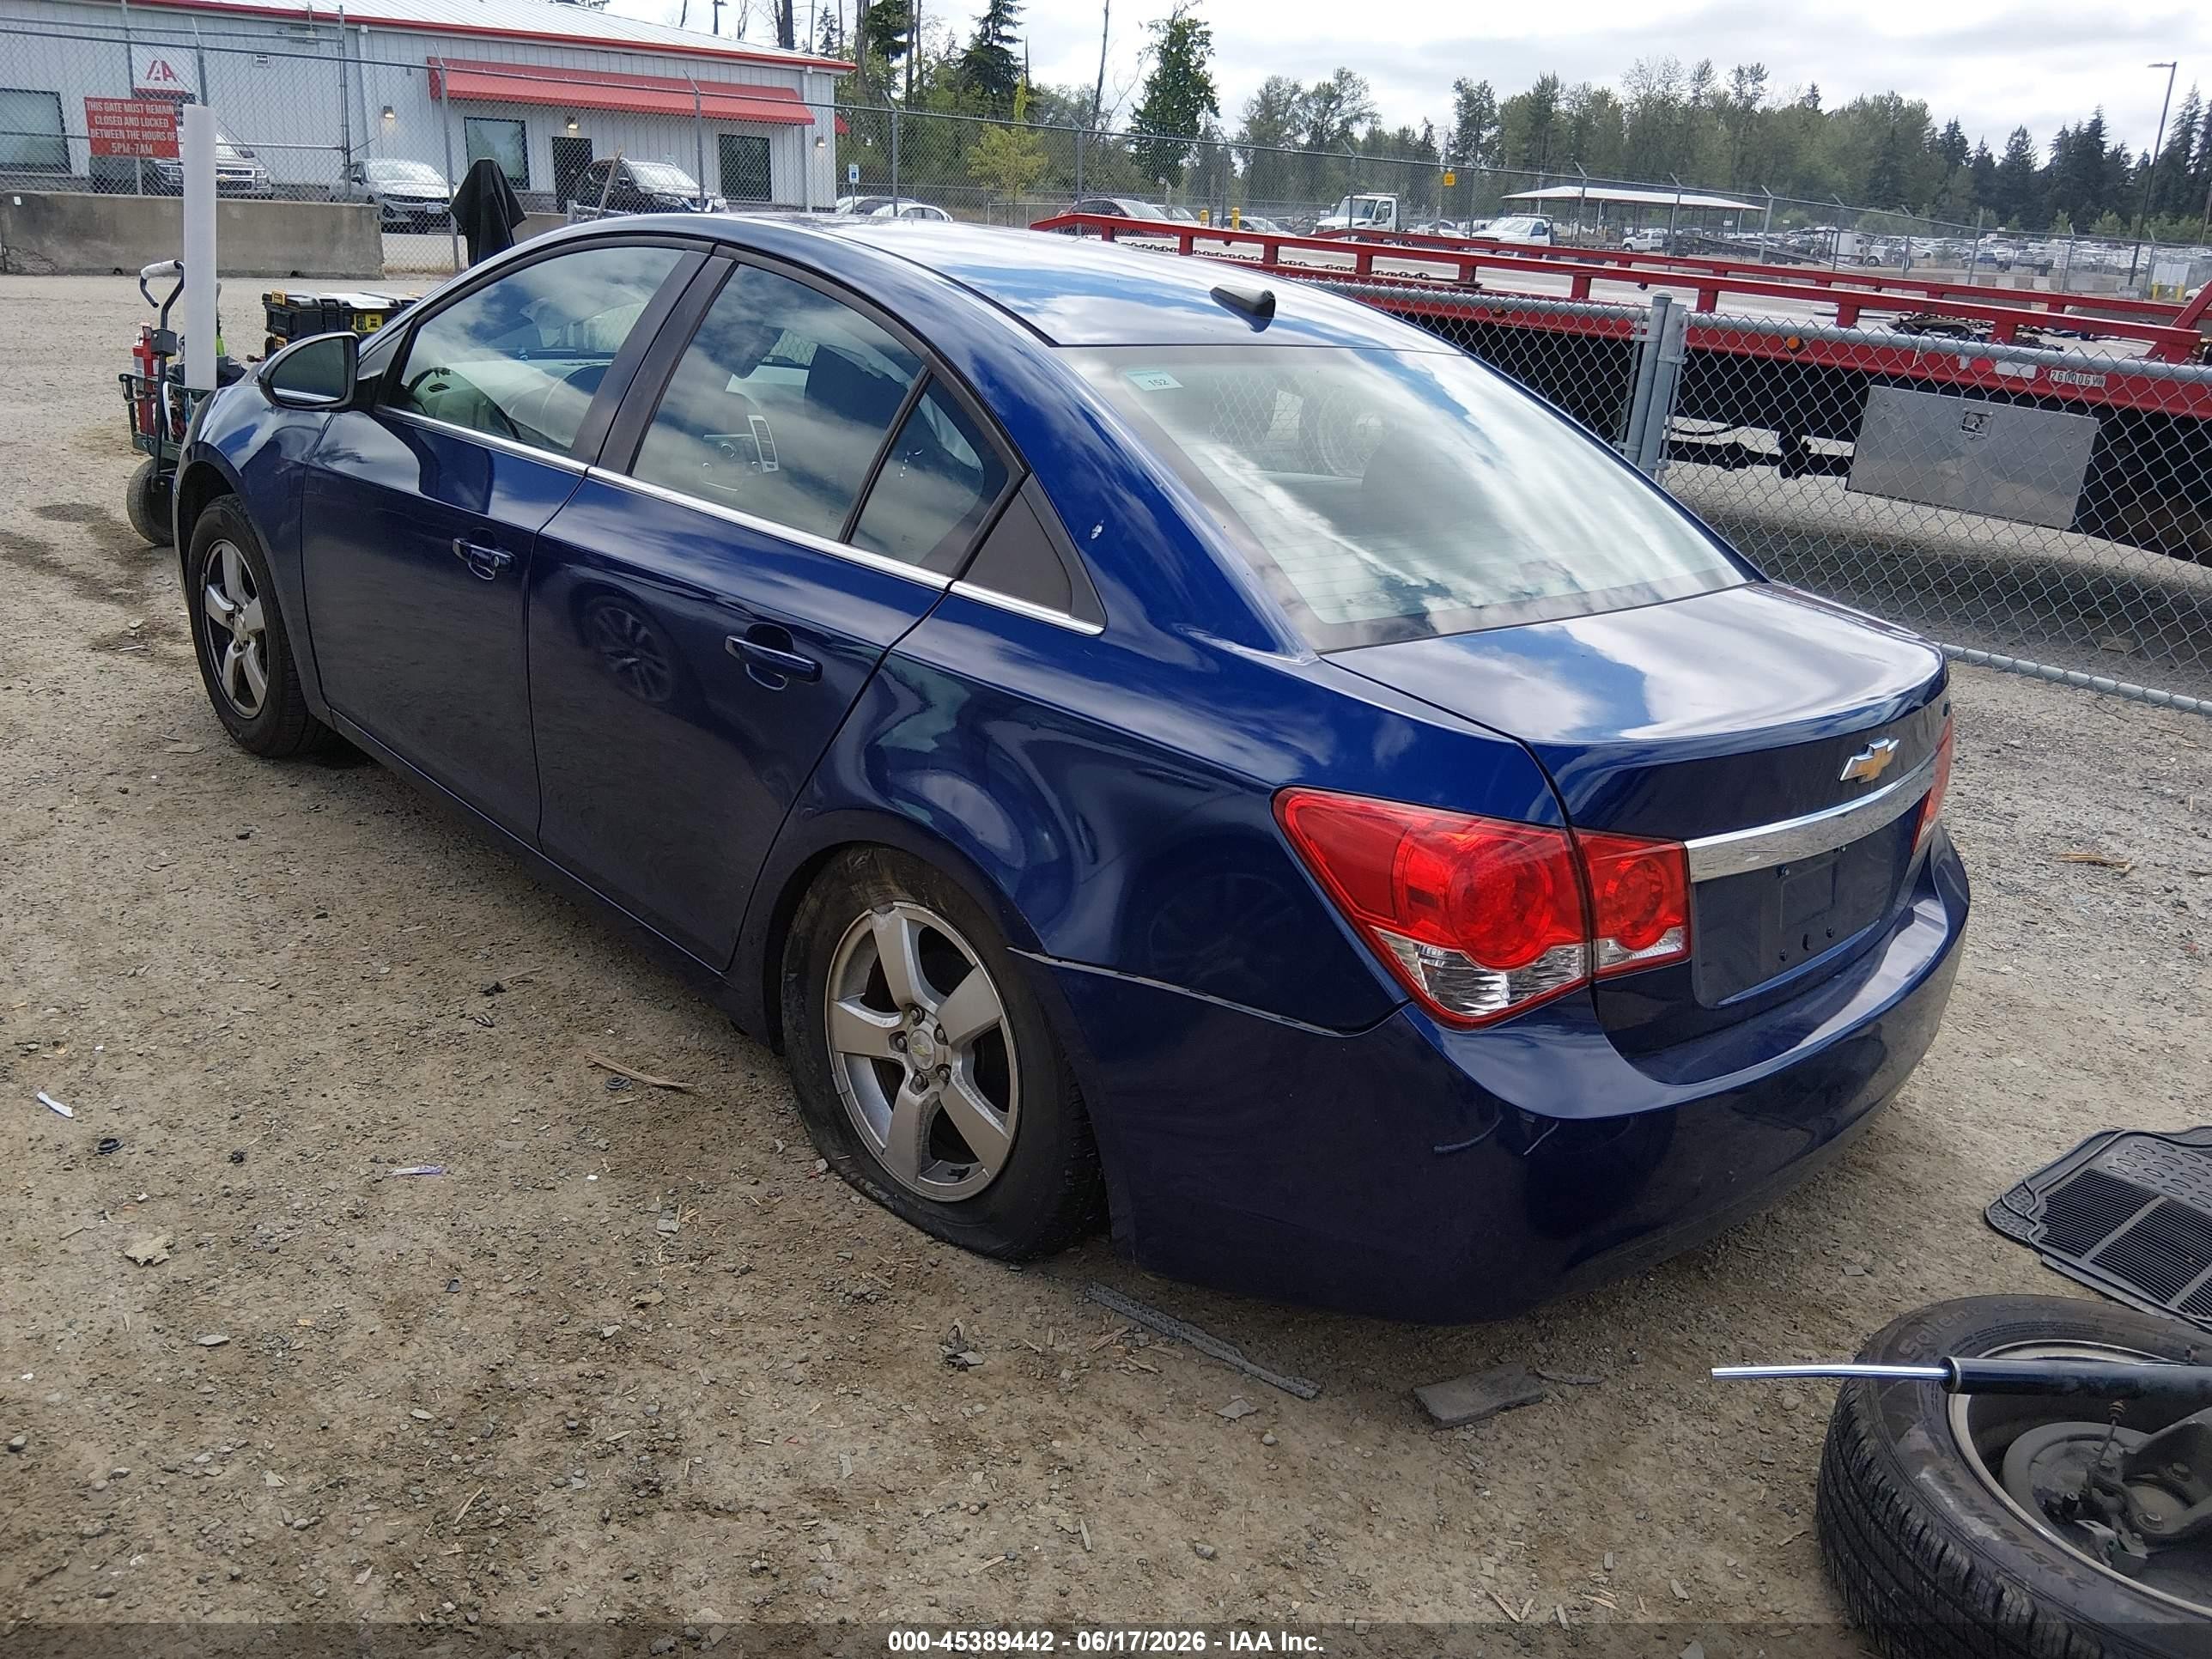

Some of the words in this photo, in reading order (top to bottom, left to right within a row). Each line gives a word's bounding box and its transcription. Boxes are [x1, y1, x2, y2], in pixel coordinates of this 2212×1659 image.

[87, 102, 103, 111] THIS
[105, 103, 122, 112] GATE
[124, 104, 143, 113] MUST
[145, 104, 174, 114] REMAIN
[95, 116, 123, 125] CLOSED
[124, 116, 139, 126] AND
[141, 118, 169, 127] LOCKED
[90, 129, 125, 139] BETWEEN
[126, 131, 140, 140] THE
[142, 131, 166, 141] HOURS
[167, 131, 176, 142] OF
[112, 143, 153, 155] 5PM-7AM
